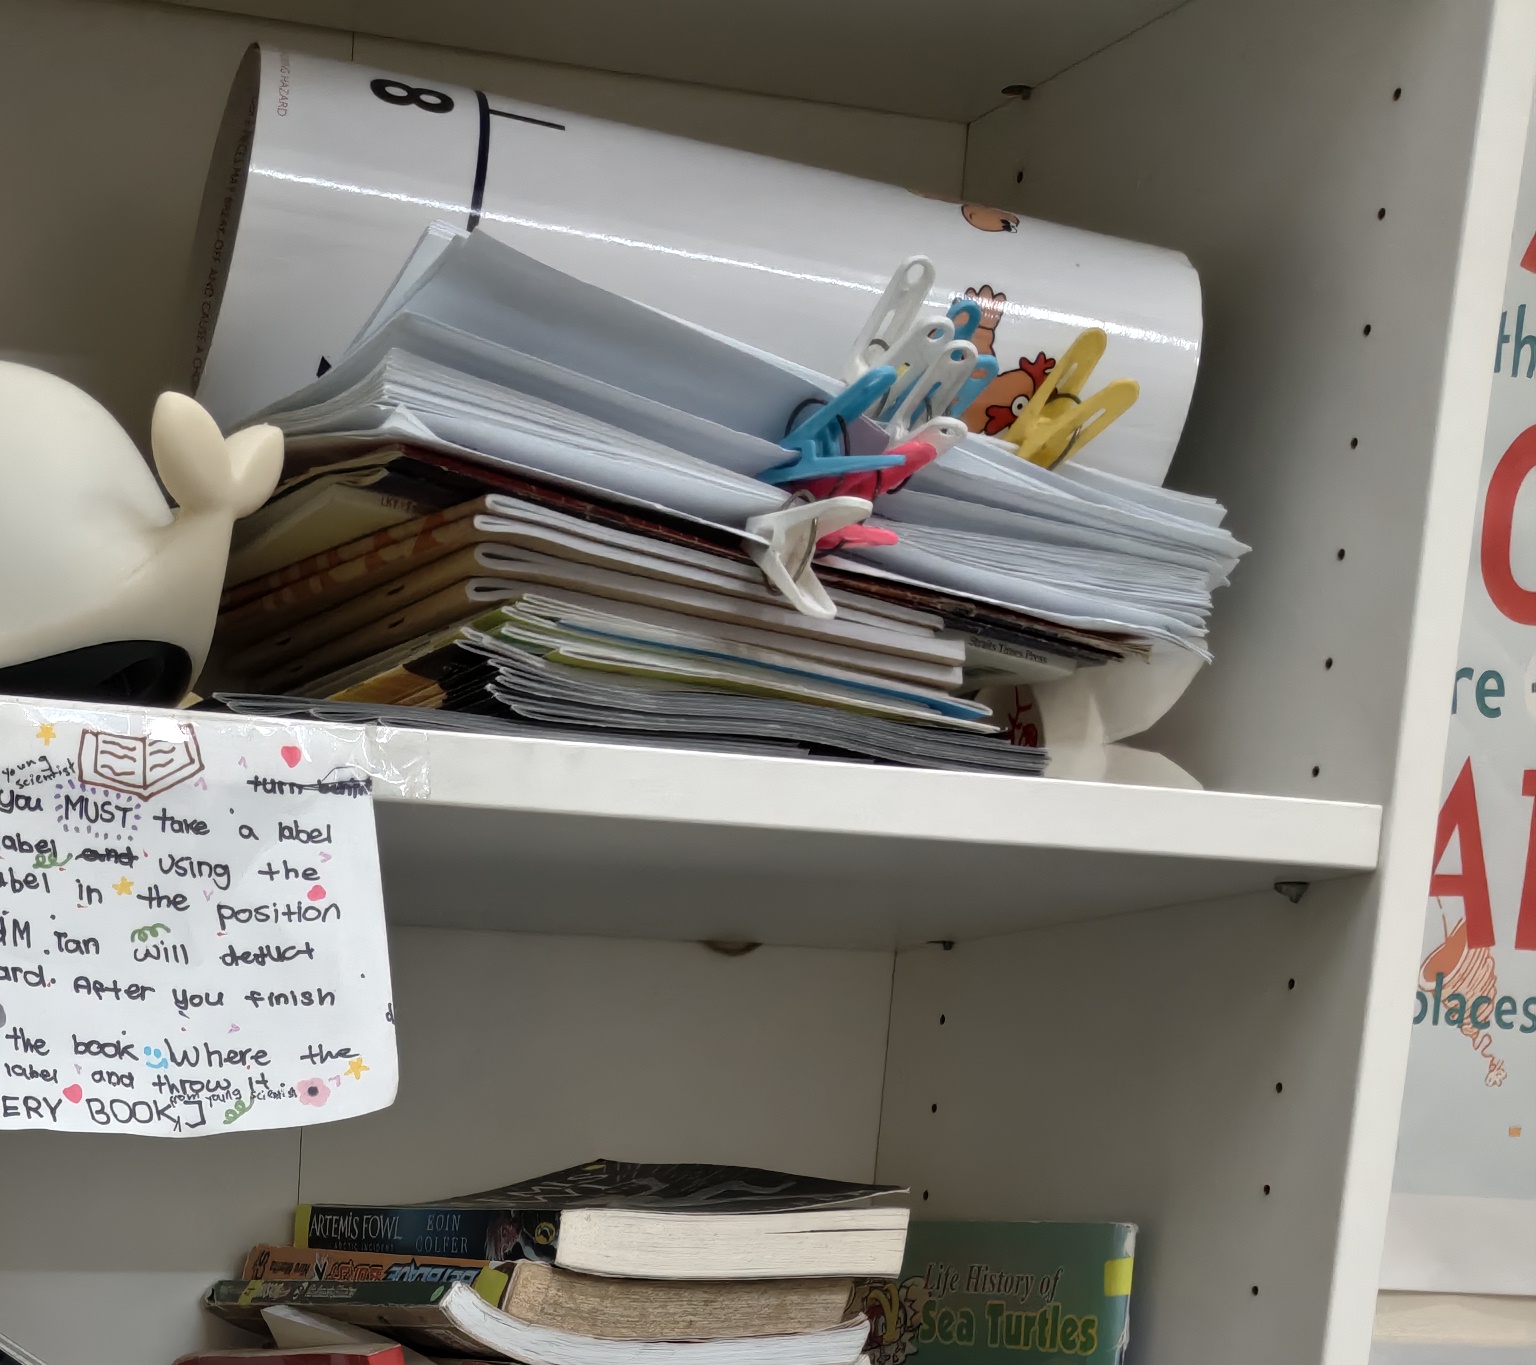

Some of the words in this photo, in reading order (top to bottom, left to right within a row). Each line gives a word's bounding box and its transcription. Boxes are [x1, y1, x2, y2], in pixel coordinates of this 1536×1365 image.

[370, 79, 454, 113] 8
[64, 797, 134, 825] MUST
[153, 808, 211, 837] take
[238, 823, 260, 841] a
[278, 821, 332, 844] label
[258, 863, 321, 882] the
[76, 878, 103, 905] in
[137, 886, 190, 911] the
[216, 901, 341, 935] position
[133, 940, 189, 965] will
[221, 944, 315, 966] deduct
[73, 976, 155, 1000] After
[173, 989, 223, 1014] you
[245, 987, 336, 1008] finish
[6, 1028, 50, 1057] the
[73, 1034, 139, 1060] book
[300, 1045, 359, 1063] the
[309, 1211, 359, 1238] ARTEMIS
[362, 1214, 402, 1241] FOWL
[923, 1262, 959, 1298] Life
[966, 1263, 1034, 1304] History
[1039, 1265, 1063, 1302] of
[919, 1299, 976, 1346] Sea
[986, 1300, 1098, 1356] Turtles
